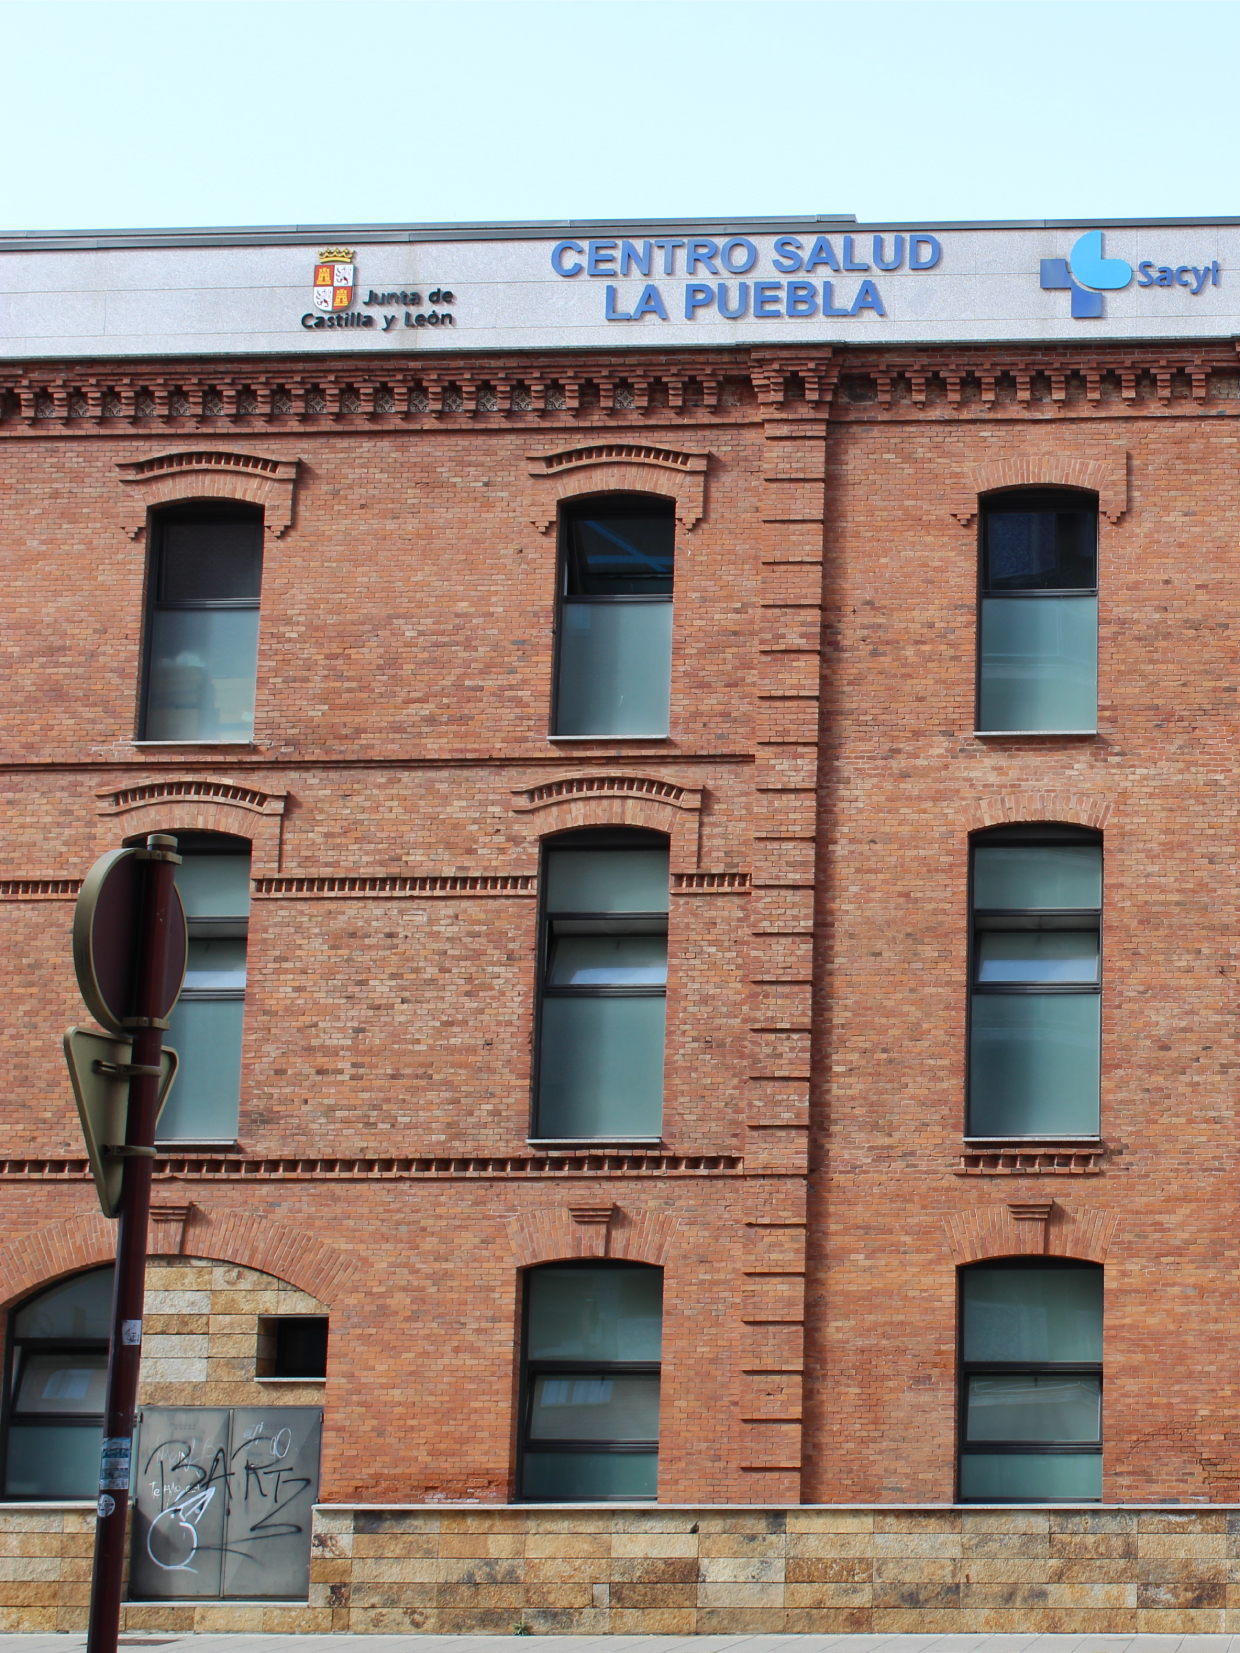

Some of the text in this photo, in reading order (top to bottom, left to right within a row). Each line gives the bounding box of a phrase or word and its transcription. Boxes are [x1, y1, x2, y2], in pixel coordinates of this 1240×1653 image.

[551, 234, 940, 277] CENTRO SALUD
[1137, 260, 1218, 294] Sacyl
[362, 288, 453, 305] Junta de
[605, 279, 885, 320] LA PUEBLA
[301, 309, 453, 331] Castilla y León
